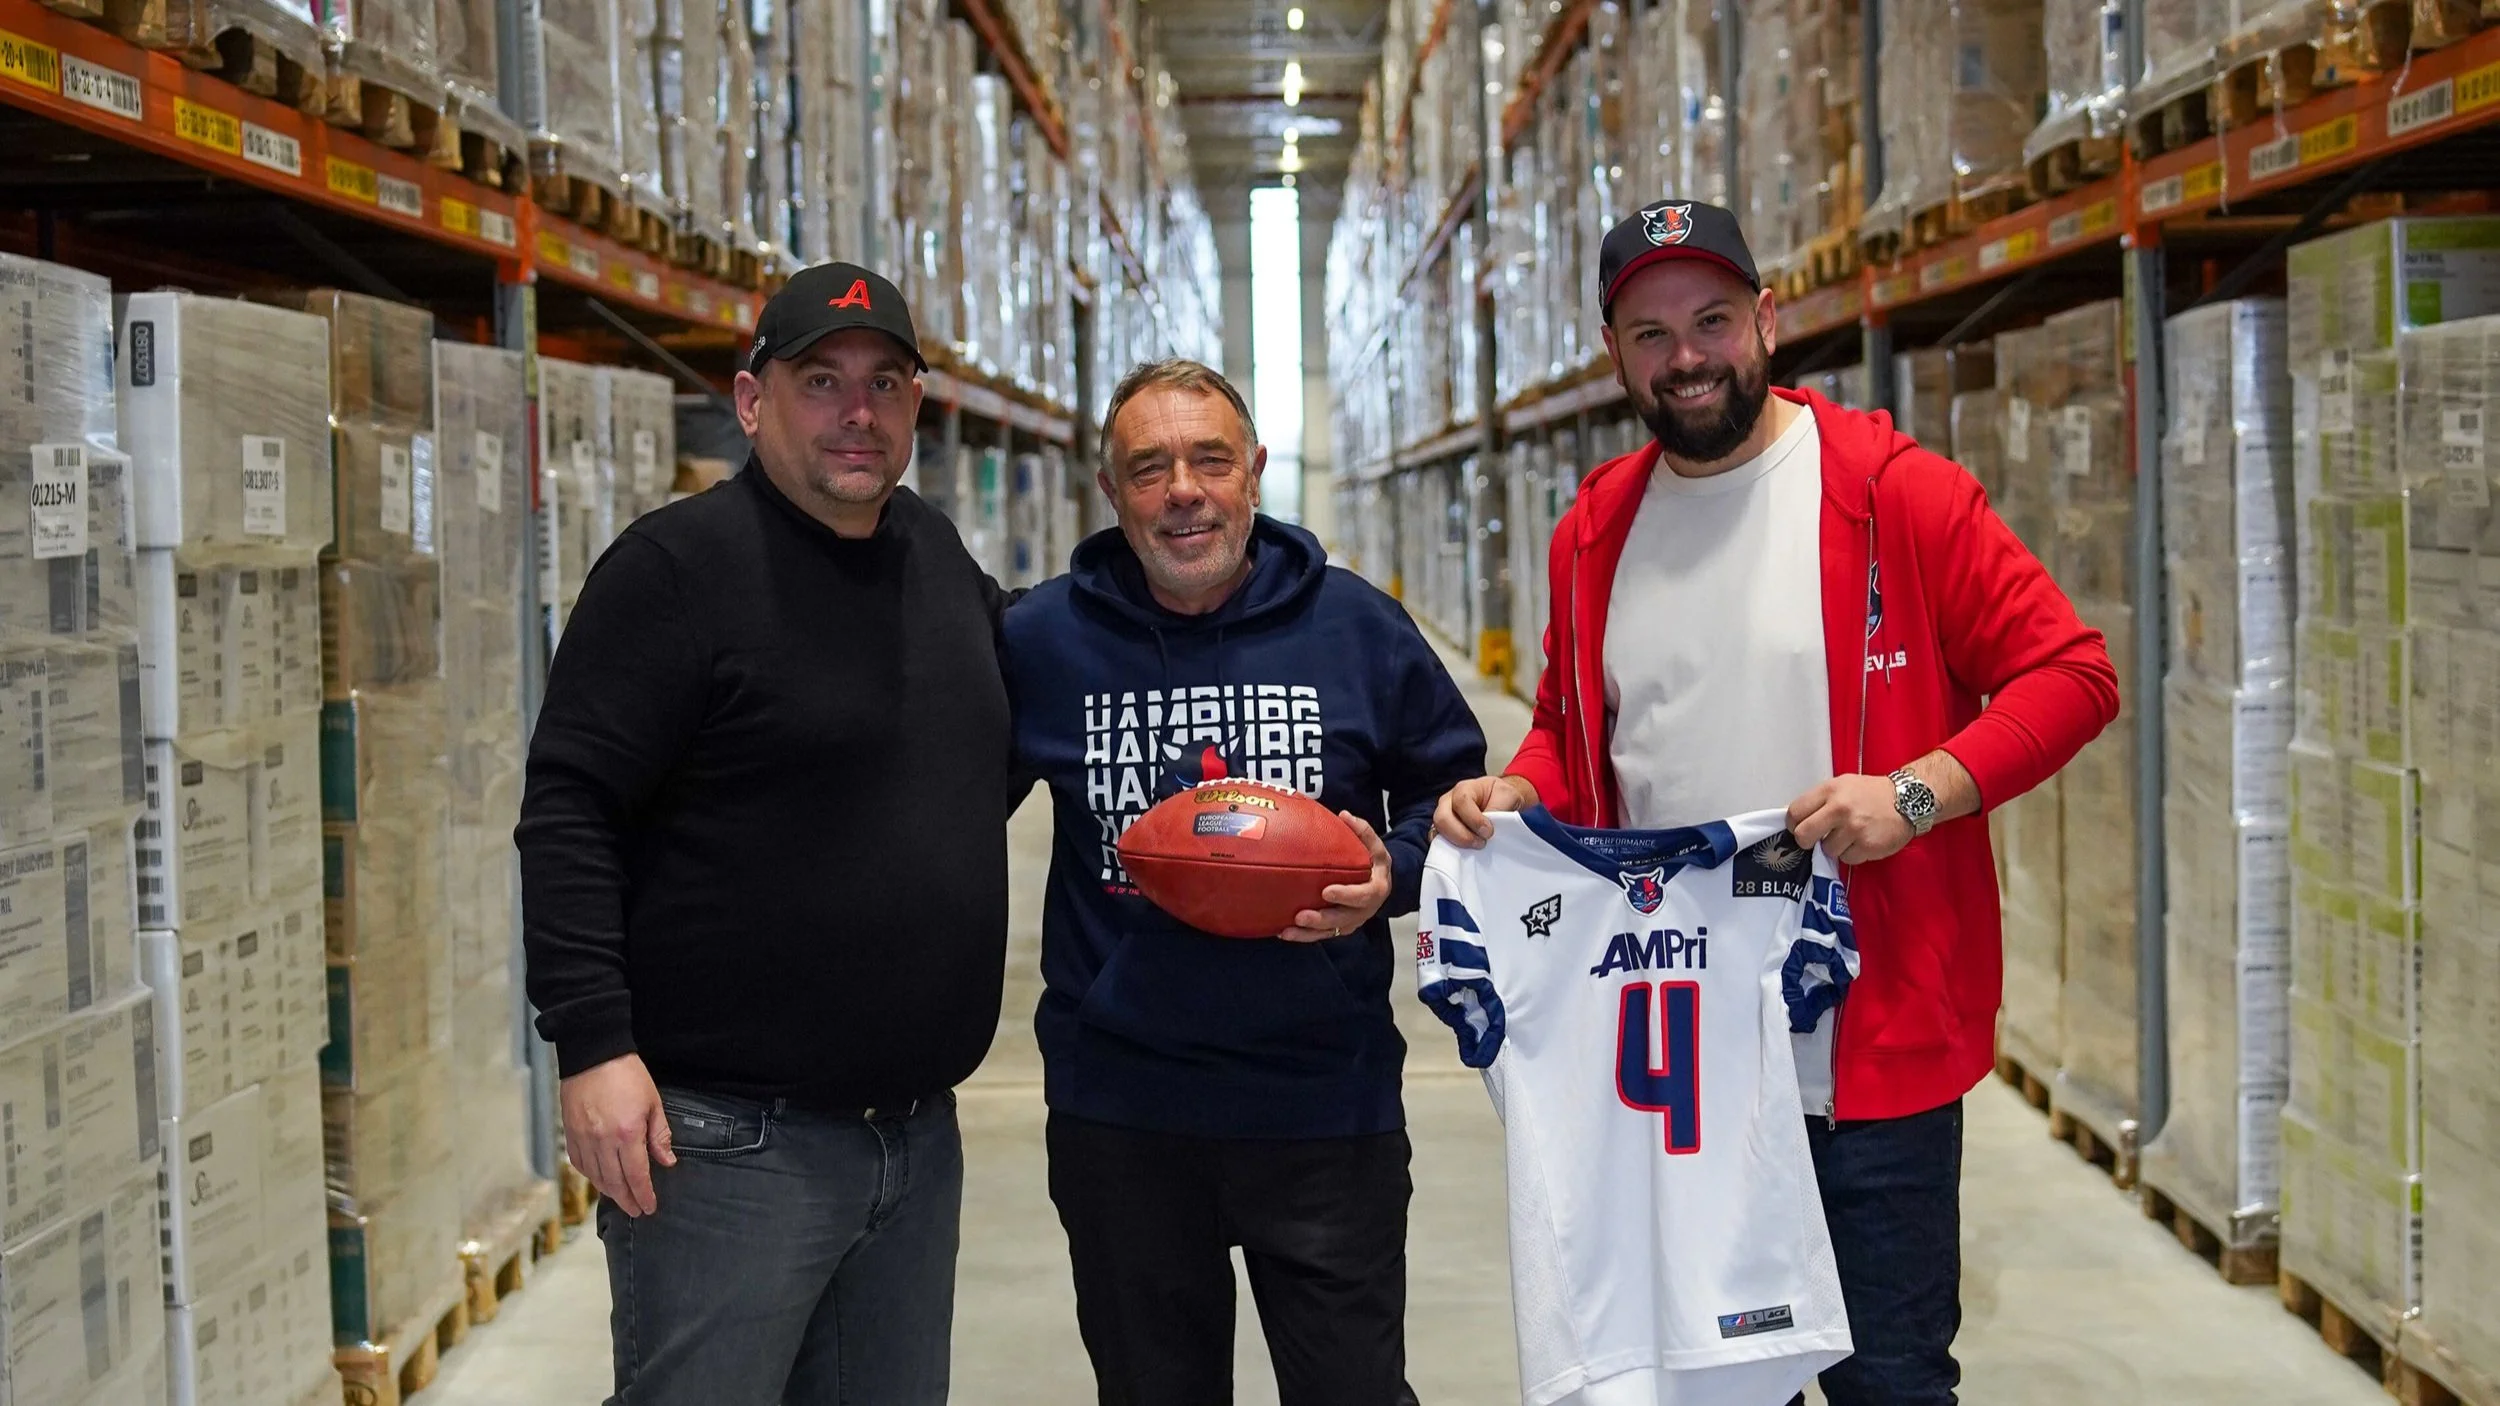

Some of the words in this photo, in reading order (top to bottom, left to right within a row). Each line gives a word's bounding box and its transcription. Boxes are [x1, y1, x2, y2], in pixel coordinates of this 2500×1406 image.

[828, 279, 871, 310] A
[32, 482, 76, 508] 01215-M
[1195, 789, 1276, 810] Wilson
[1736, 881, 1756, 894] 28
[1762, 881, 1803, 899] BLAK
[1590, 927, 1708, 978] AMPri
[1615, 980, 1701, 1155] 4
[1767, 1308, 1787, 1319] ACE
